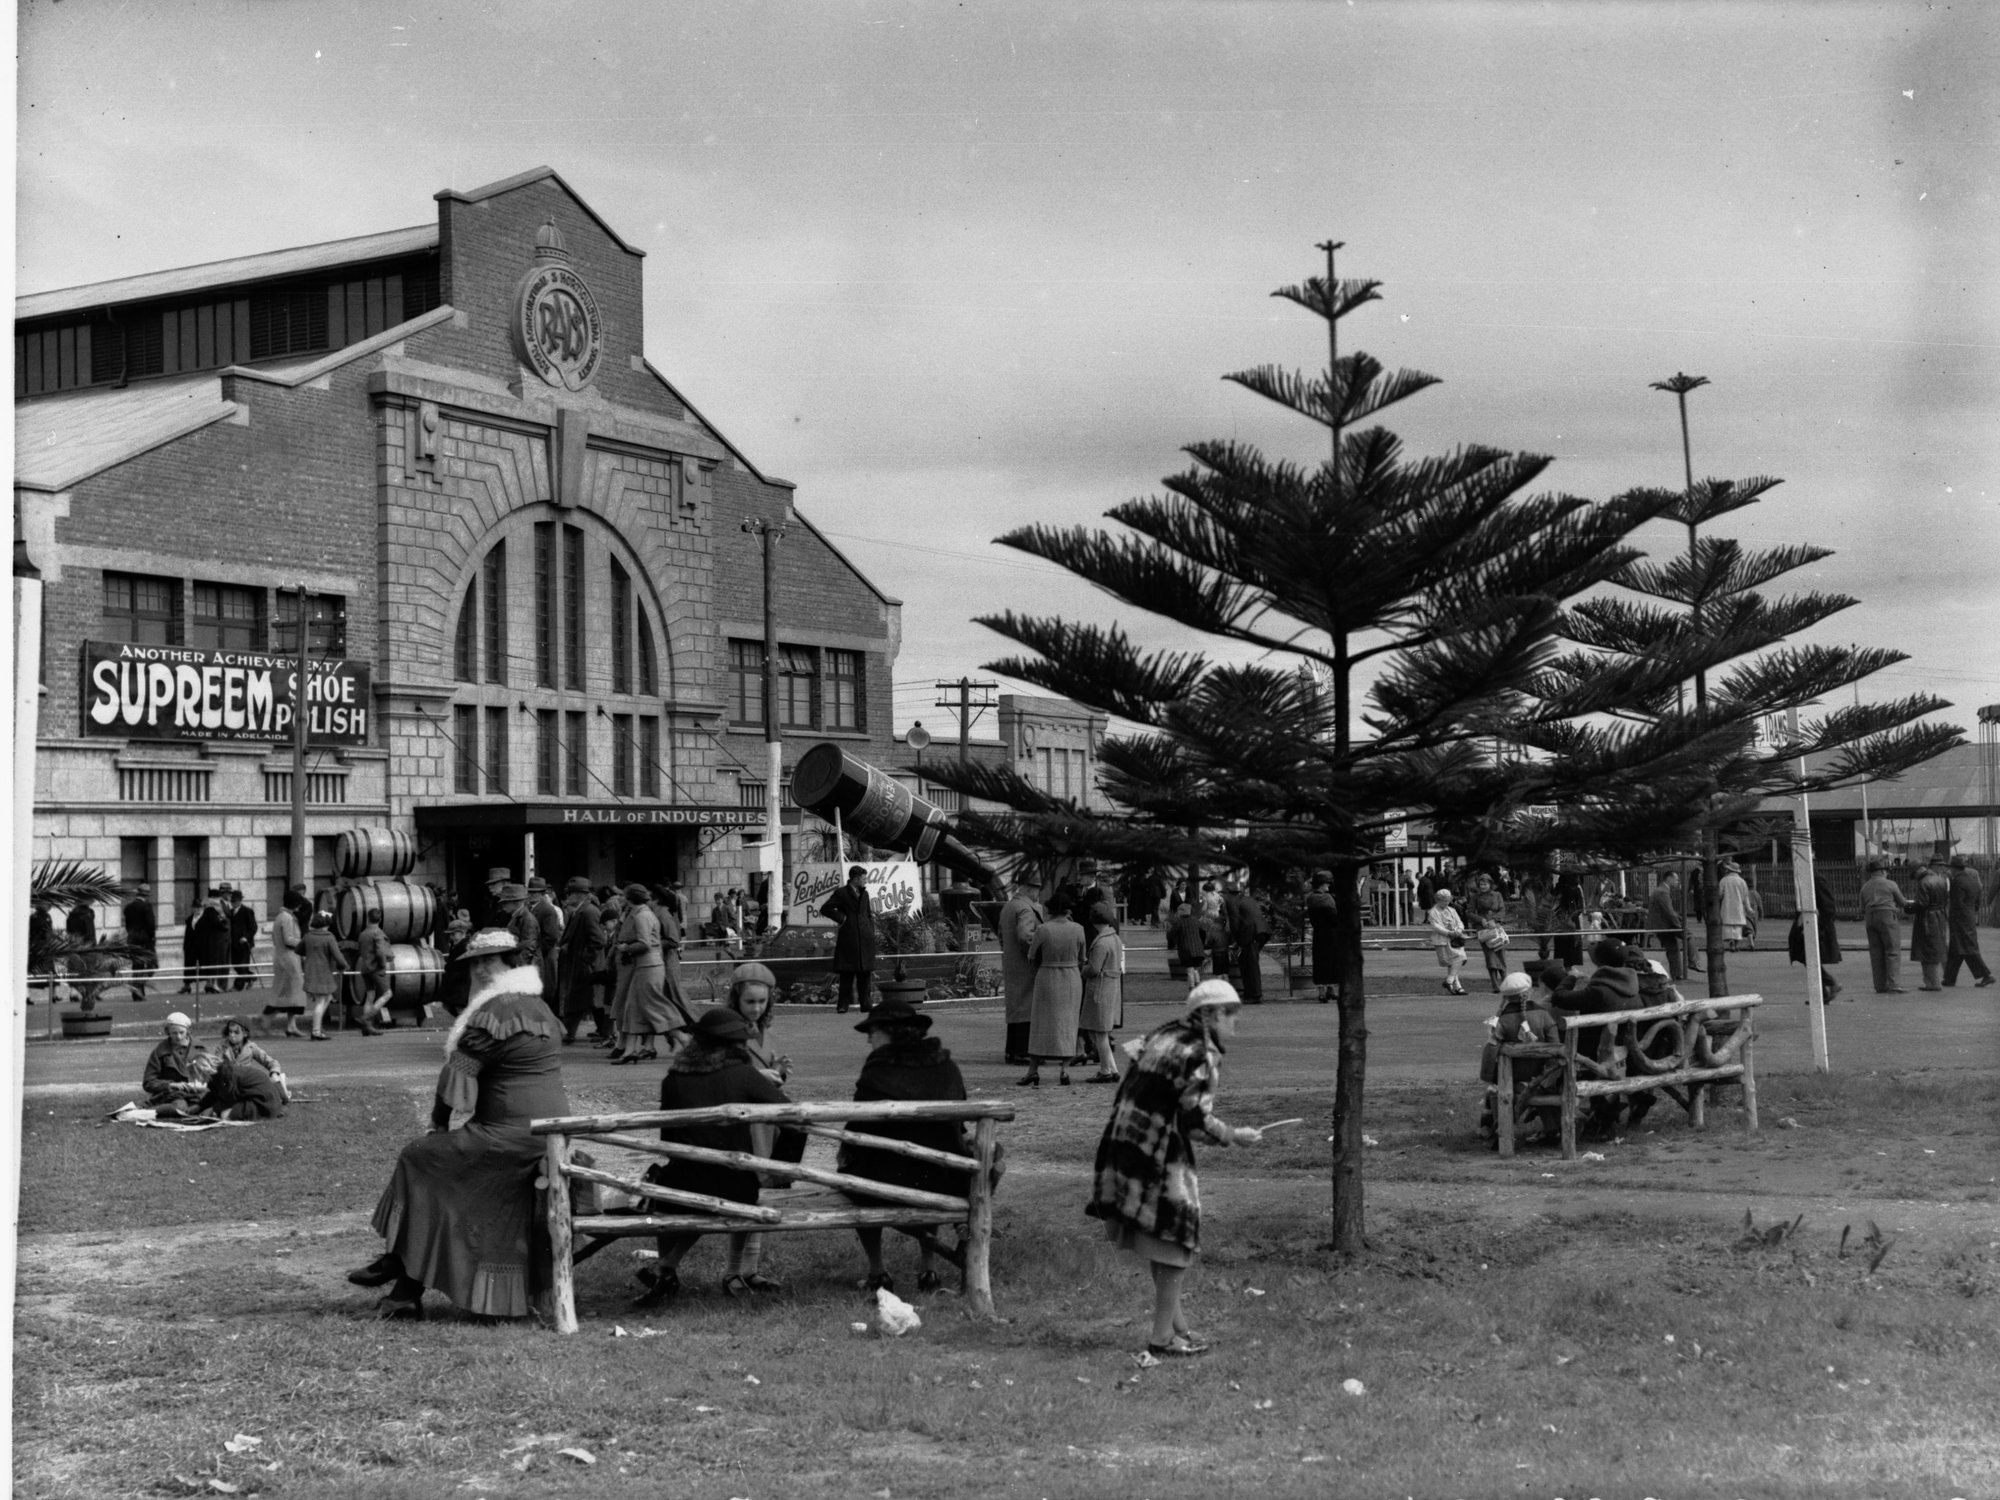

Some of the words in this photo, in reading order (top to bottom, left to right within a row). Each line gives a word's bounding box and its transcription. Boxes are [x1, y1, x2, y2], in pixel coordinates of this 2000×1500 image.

[120, 644, 205, 664] ANOTHER
[90, 660, 273, 731] SUPREEM
[181, 730, 213, 739] MADE
[218, 731, 228, 739] IN
[234, 732, 289, 741] ADELAIDE
[563, 809, 621, 823] HALL
[627, 812, 645, 822] OF
[651, 810, 768, 823] INDUSTRIES
[794, 870, 840, 905] Penfolds
[869, 880, 915, 913] nfolds
